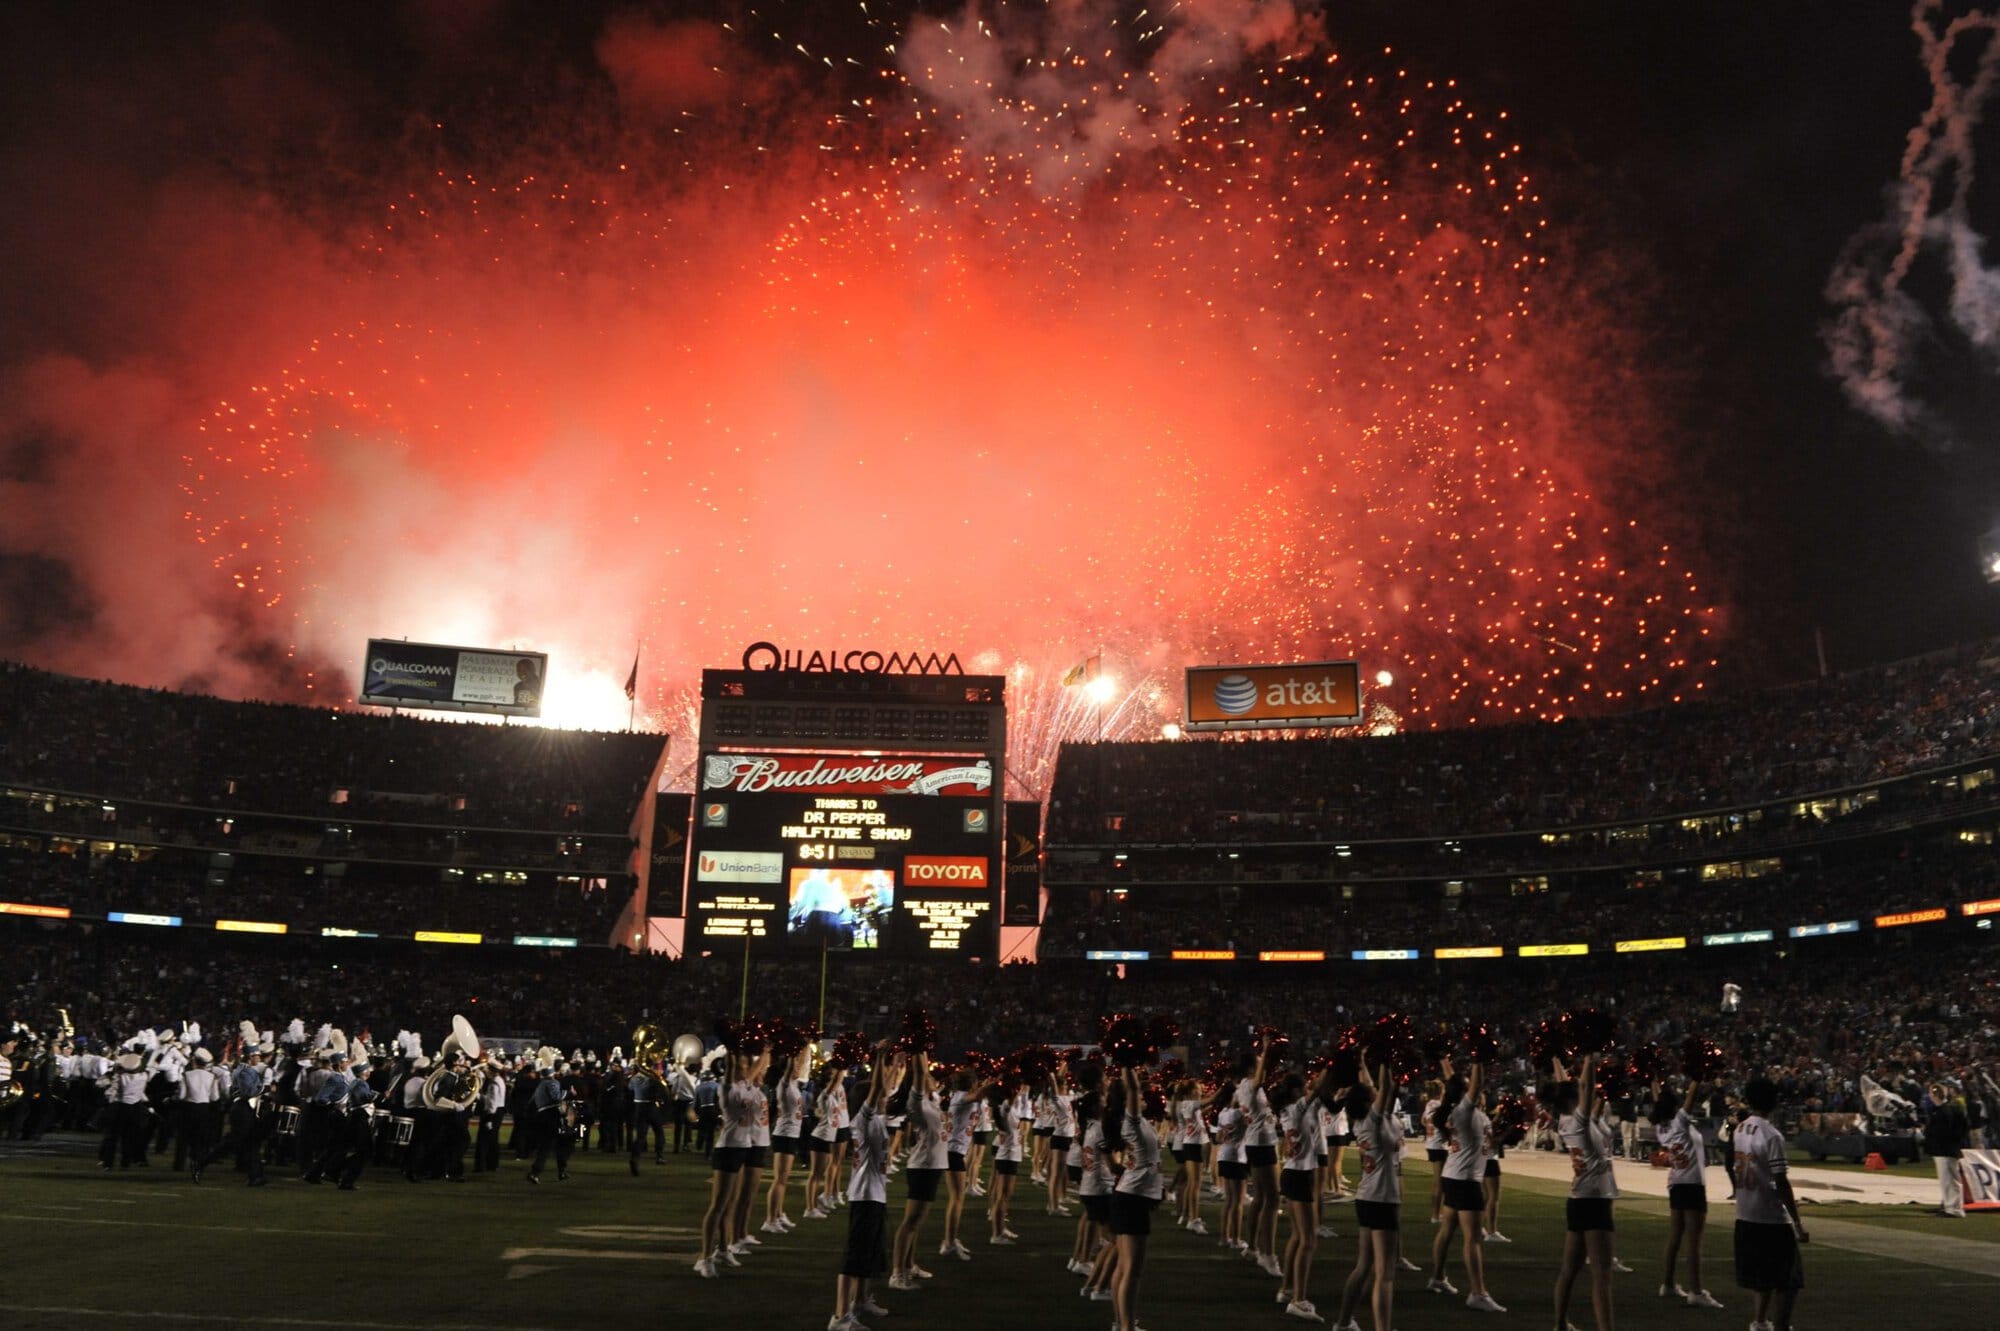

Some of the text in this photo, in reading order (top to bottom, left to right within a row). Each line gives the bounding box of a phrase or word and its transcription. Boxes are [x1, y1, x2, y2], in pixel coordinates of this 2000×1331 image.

[742, 642, 964, 676] QUALCOMM
[371, 659, 451, 676] QUALCOMM
[1266, 676, 1337, 706] at&t
[730, 757, 923, 793] Budweiser
[815, 798, 878, 810] THANKS TO
[803, 811, 886, 825] DR PEPPER
[781, 826, 912, 840] HALFTIME SHOW
[720, 861, 780, 873] UnionBank
[908, 864, 984, 880] TOYOTA
